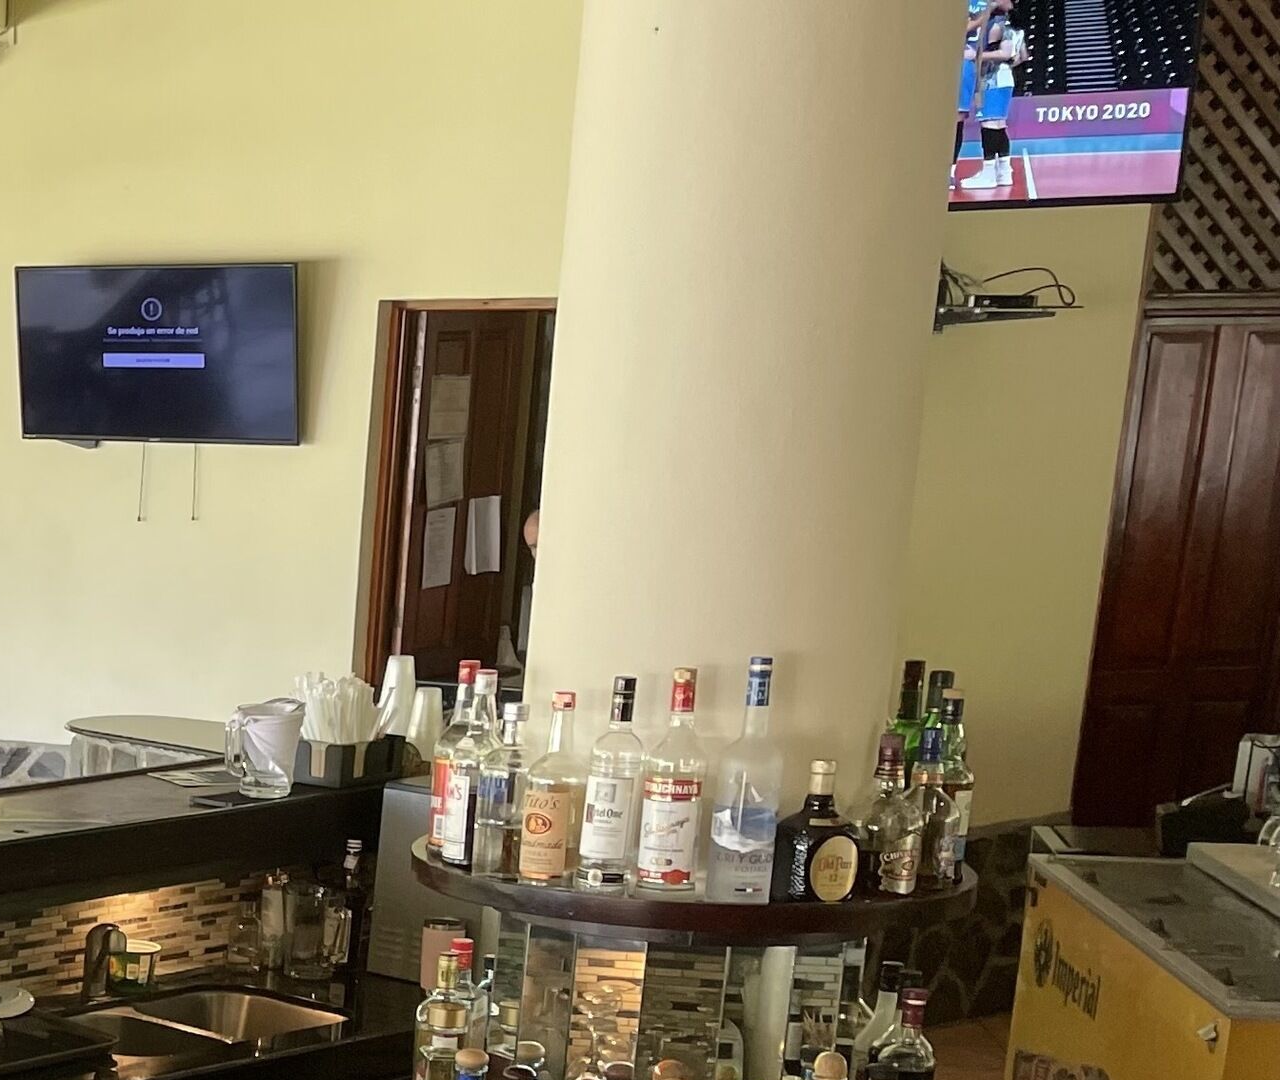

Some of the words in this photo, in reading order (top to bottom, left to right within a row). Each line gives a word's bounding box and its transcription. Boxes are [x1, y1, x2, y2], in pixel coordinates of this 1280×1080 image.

[1036, 104, 1099, 123] TOKYO
[1103, 102, 1151, 120] 2020
[524, 793, 561, 810] Tito's
[607, 808, 625, 819] One
[1052, 940, 1102, 1021] Imperial
